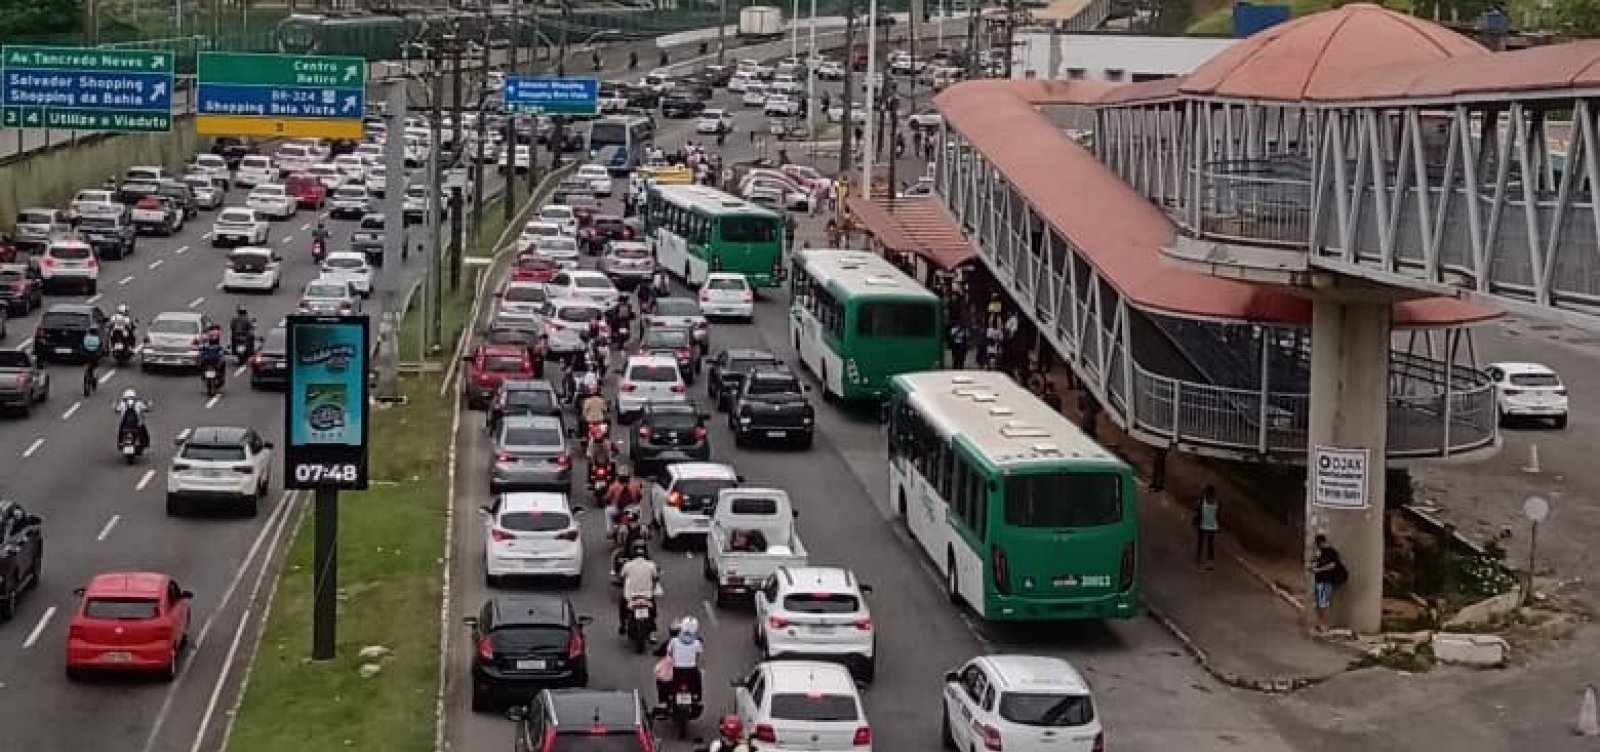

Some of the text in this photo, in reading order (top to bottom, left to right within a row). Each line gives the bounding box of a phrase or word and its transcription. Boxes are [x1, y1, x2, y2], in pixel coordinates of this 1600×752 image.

[32, 52, 98, 67] Tancredo
[101, 54, 143, 68] Neves
[294, 61, 338, 73] Centro
[10, 73, 144, 93] Salvador Shopping
[296, 73, 338, 85] Retiro
[10, 89, 143, 106] Shopping da Bahia
[205, 100, 337, 116] Shopping Bela Vista
[7, 111, 17, 123] 3
[26, 112, 38, 124] 4
[49, 111, 97, 125] Utilize
[114, 114, 168, 128] Viaduto
[295, 463, 358, 483] 07:48
